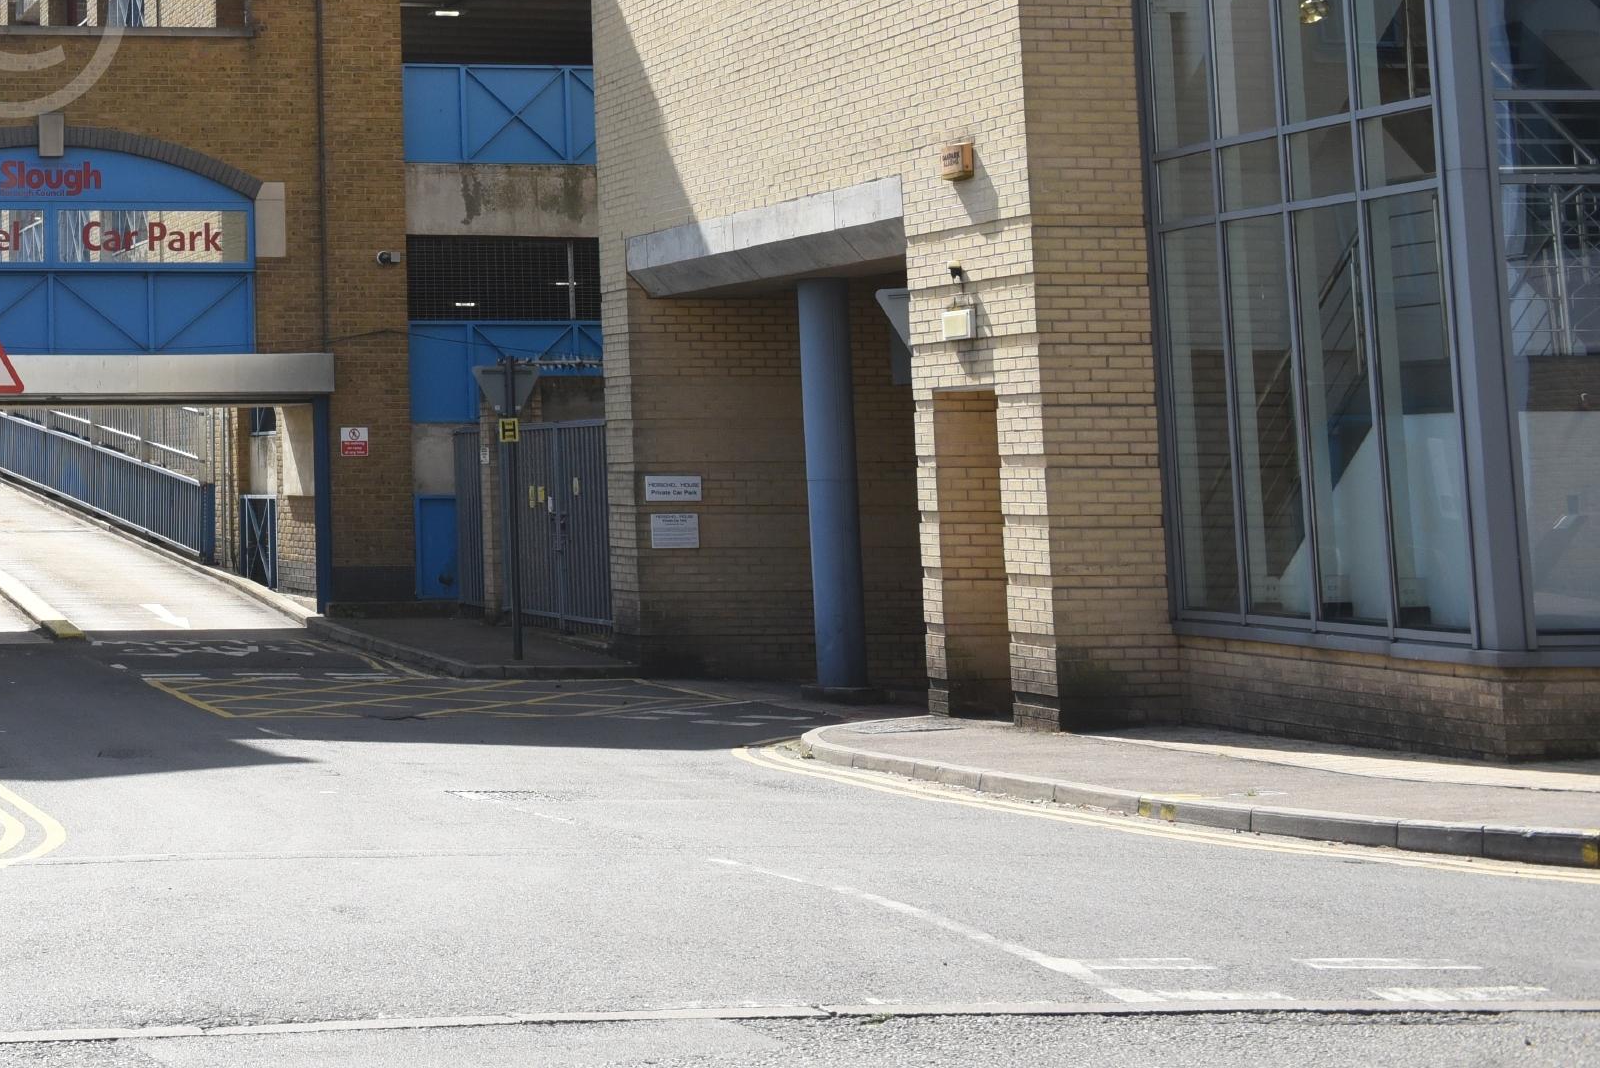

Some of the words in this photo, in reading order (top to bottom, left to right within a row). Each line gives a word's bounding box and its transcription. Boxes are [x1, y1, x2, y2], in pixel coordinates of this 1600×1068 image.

[0, 160, 102, 196] Slough
[36, 189, 65, 197] Council
[82, 220, 138, 252] Car
[148, 220, 223, 252] Park
[502, 421, 517, 440] H
